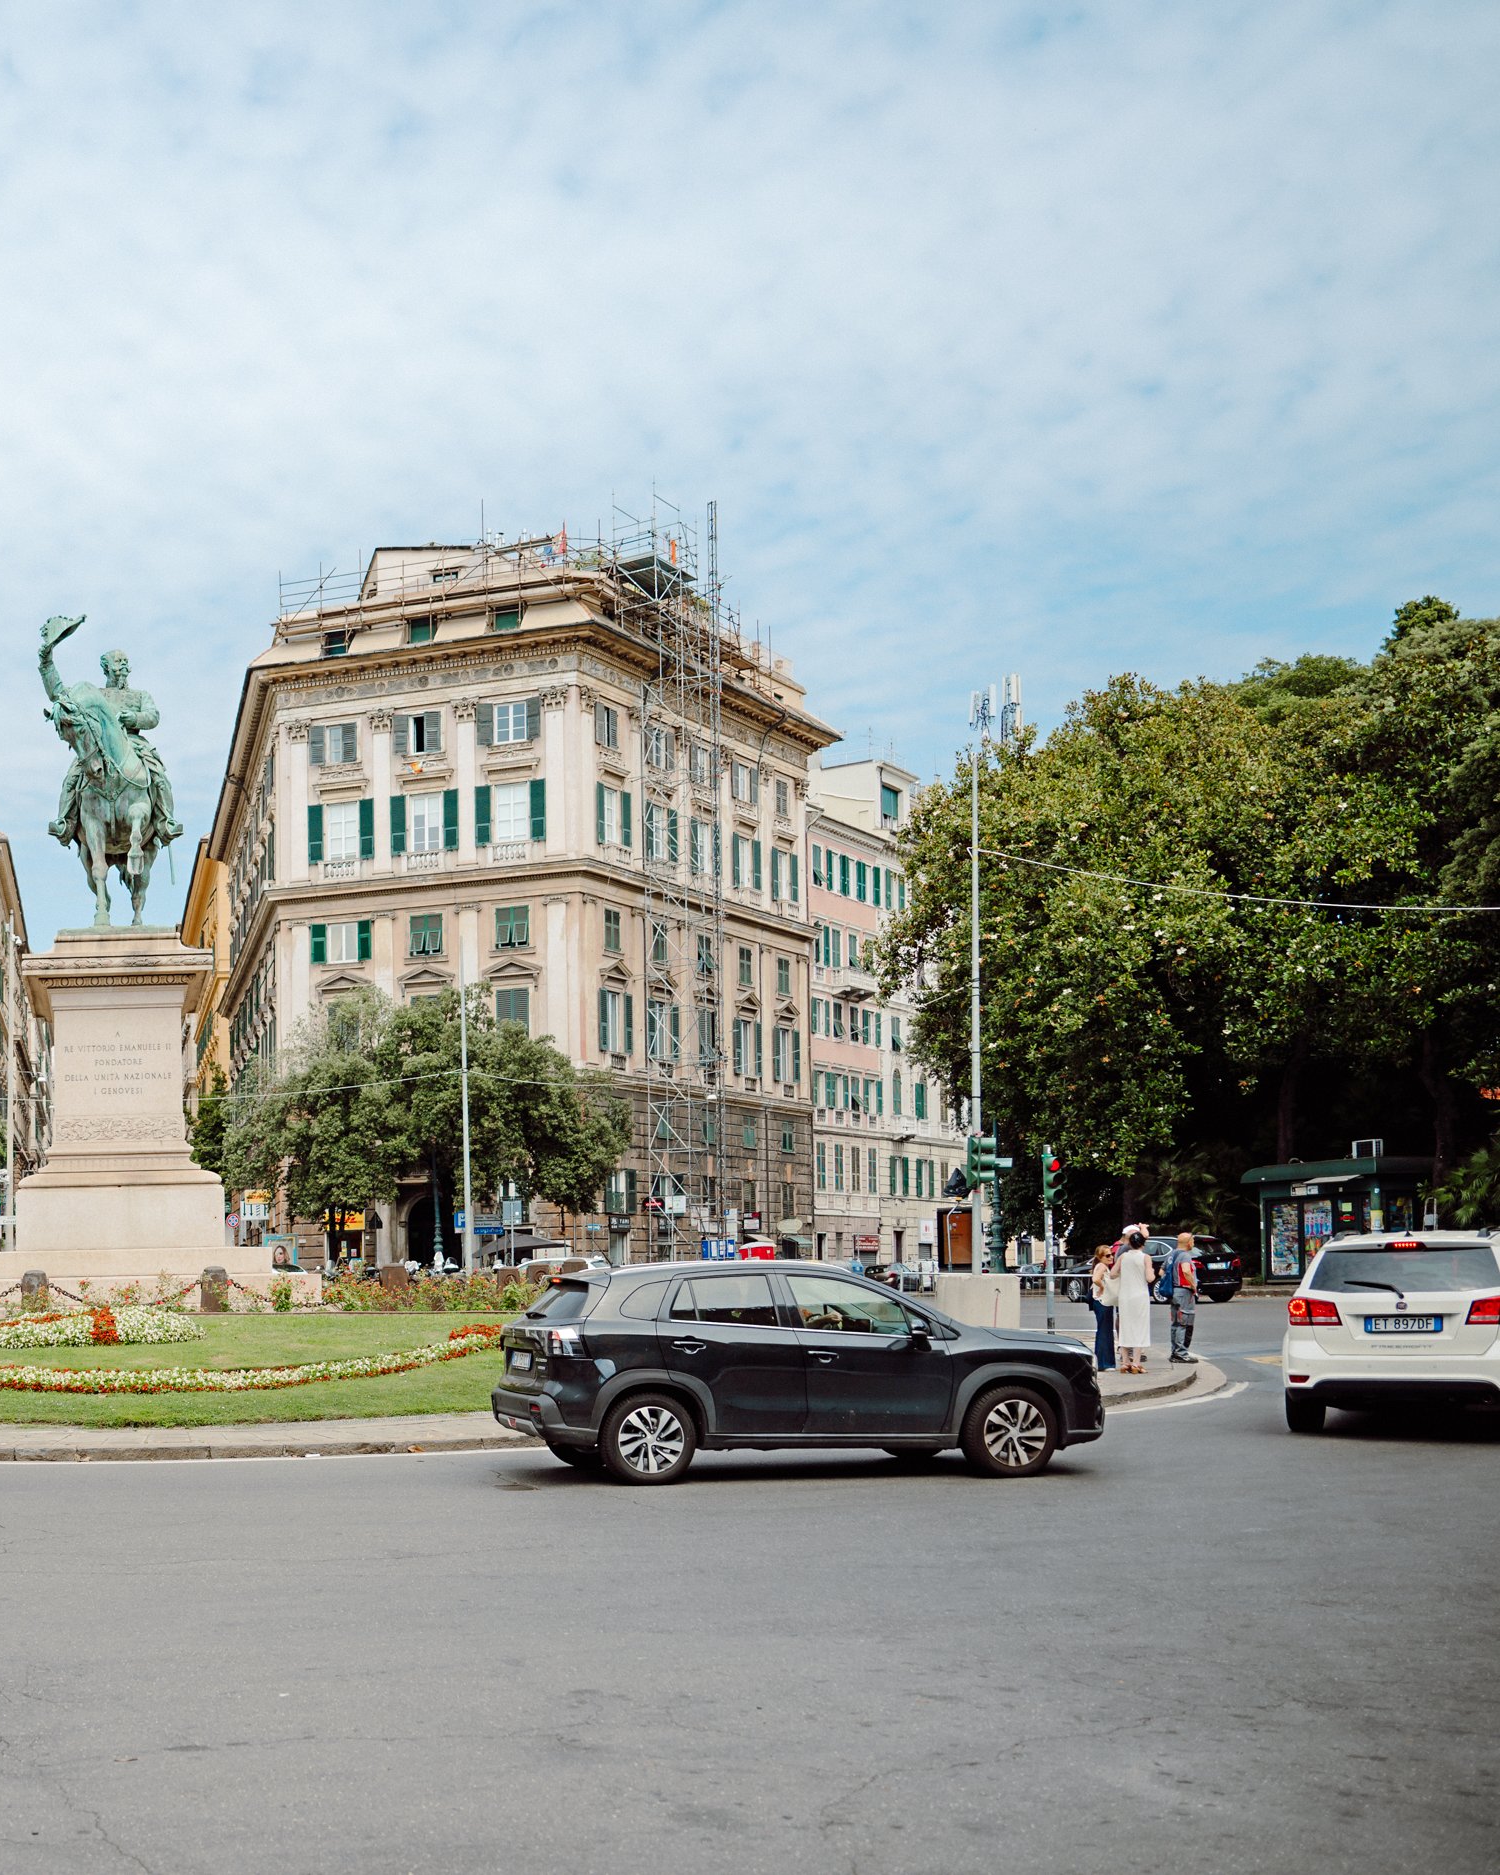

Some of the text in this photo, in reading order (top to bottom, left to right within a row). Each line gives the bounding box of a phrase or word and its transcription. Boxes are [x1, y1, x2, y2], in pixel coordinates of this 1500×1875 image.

[78, 1044, 116, 1053] VITTORIO
[120, 1043, 161, 1052] EMANUELE
[165, 1043, 172, 1051] II
[94, 1058, 143, 1066] FONDATORE
[64, 1074, 89, 1082] DELLA
[124, 1072, 172, 1081] NAZIONALE
[101, 1087, 143, 1095] GENOVESI
[1374, 1318, 1434, 1330] ET 897DF
